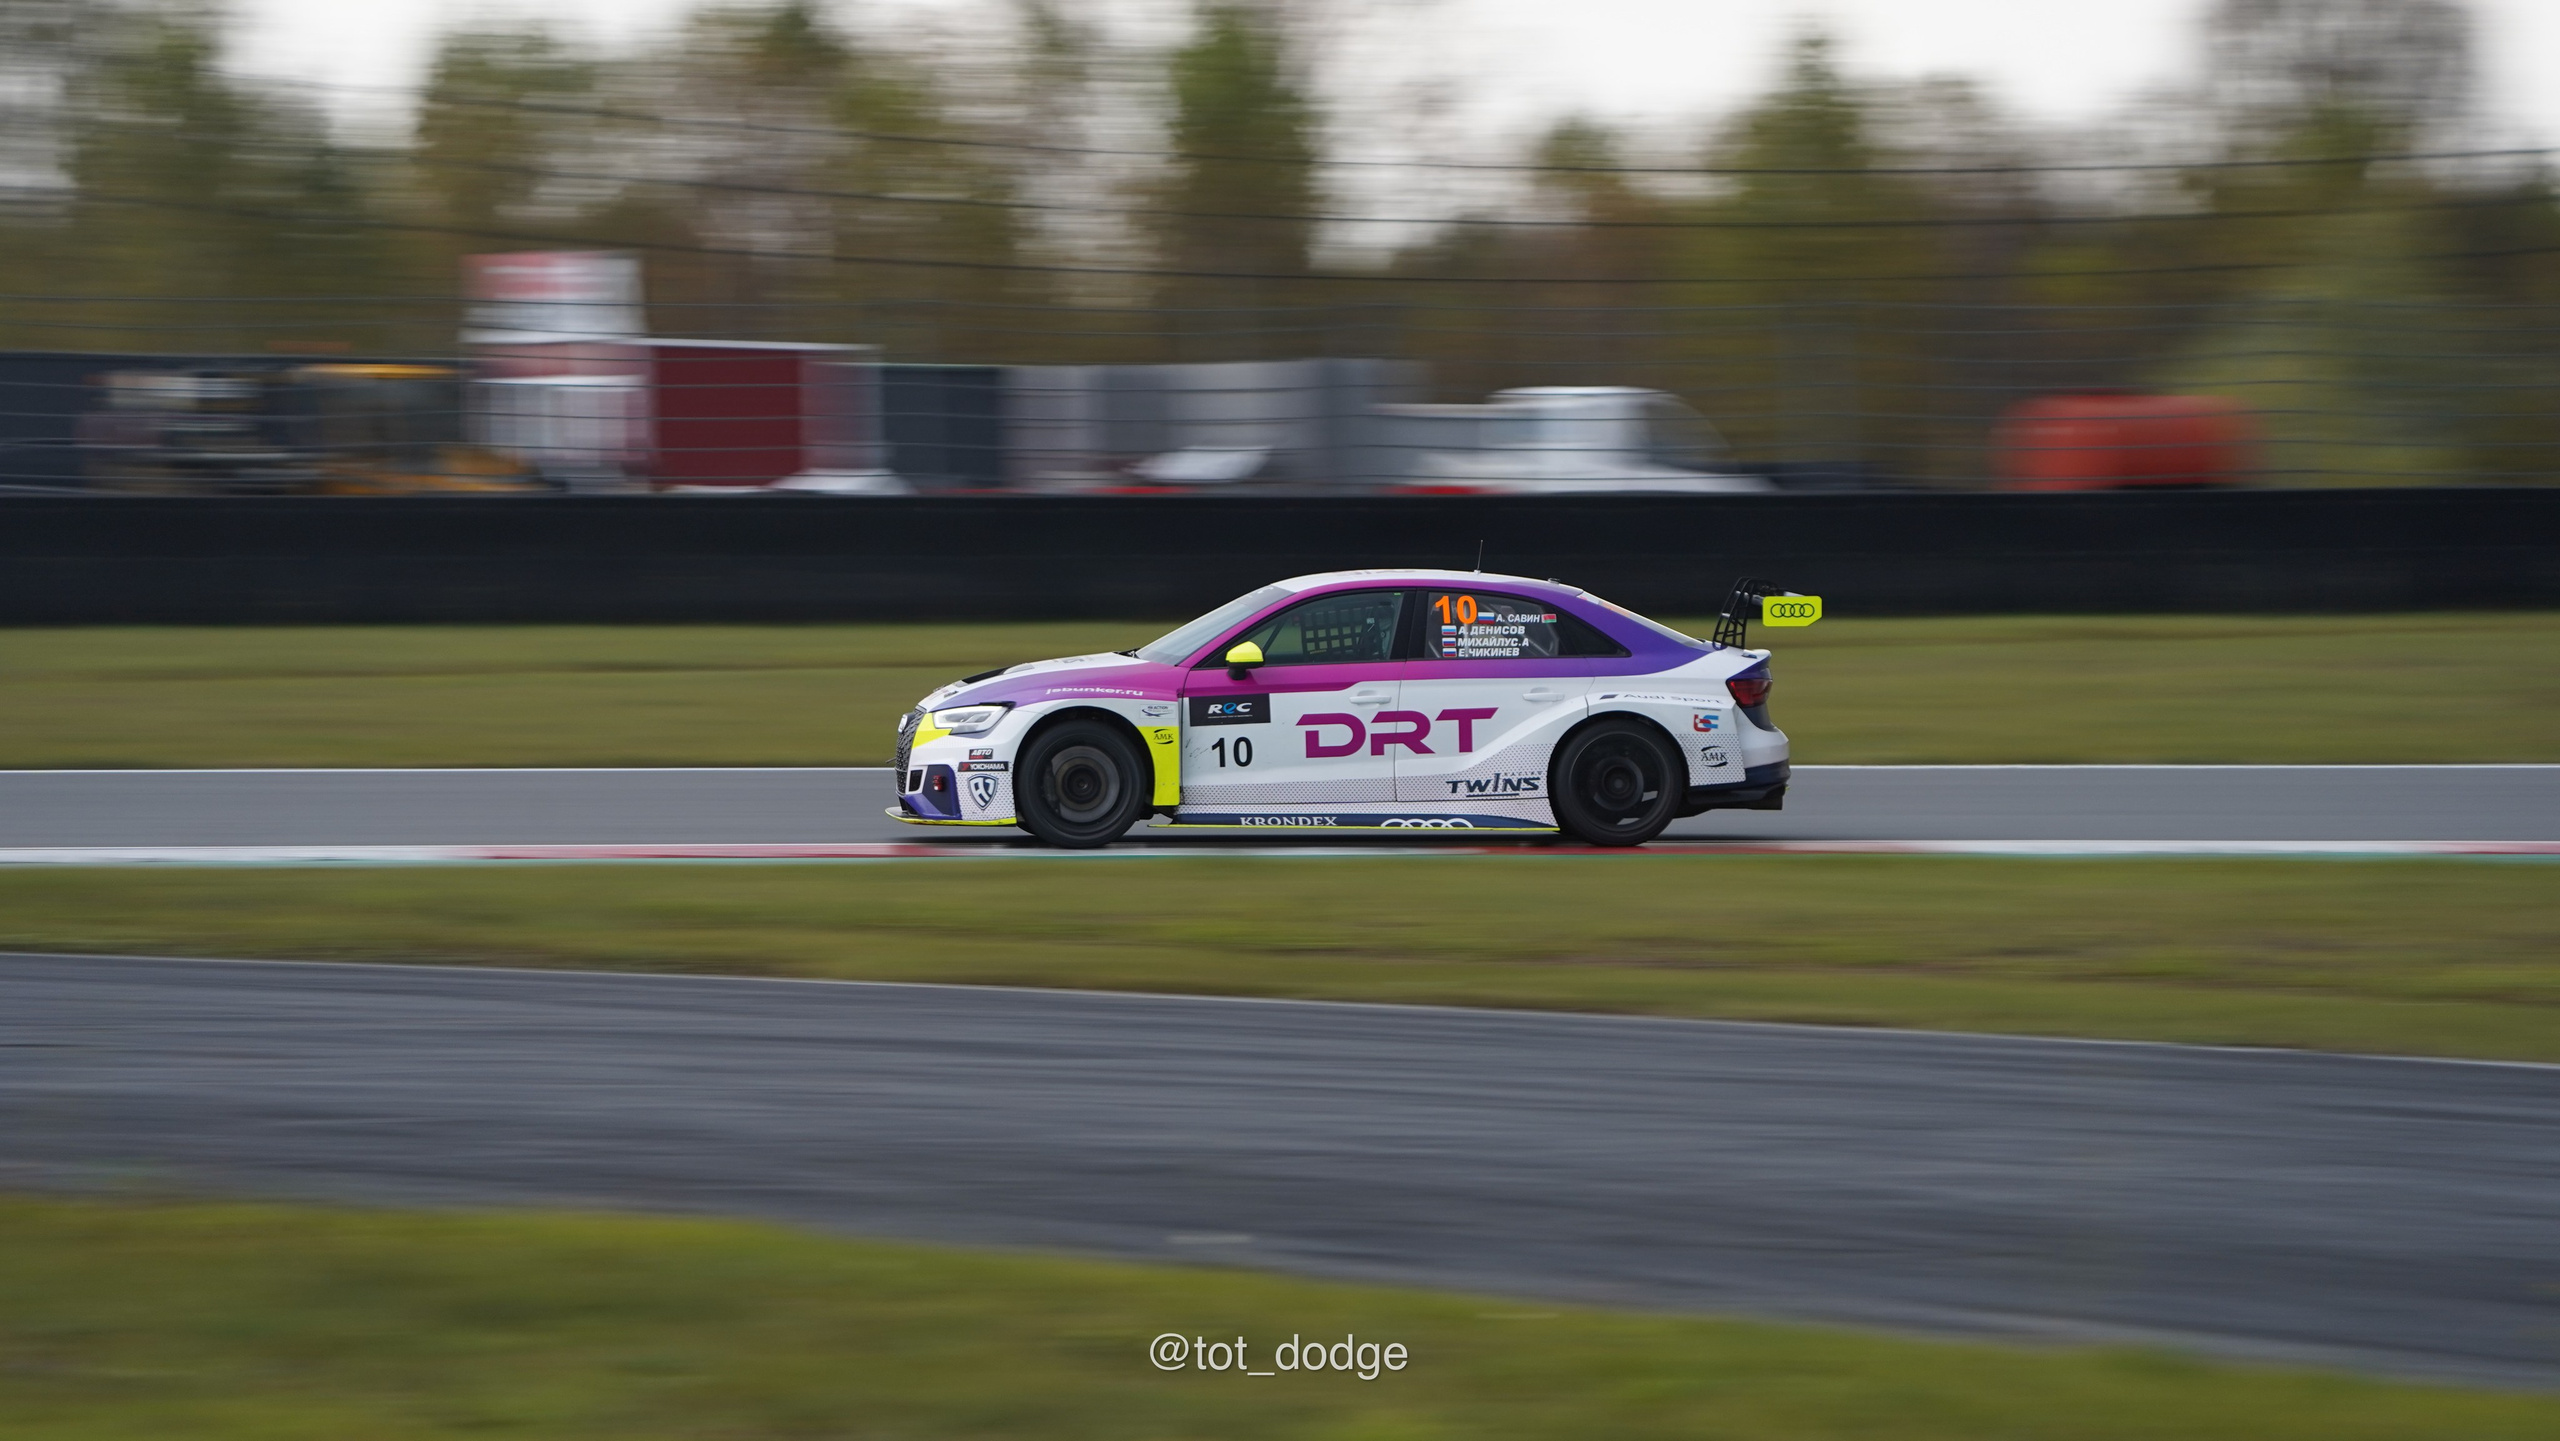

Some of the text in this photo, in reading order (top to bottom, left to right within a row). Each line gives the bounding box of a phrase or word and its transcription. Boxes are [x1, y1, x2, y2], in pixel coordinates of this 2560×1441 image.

[1434, 595, 1478, 625] 10
[1508, 613, 1541, 624] САВИН
[1295, 707, 1499, 758] DRT
[1211, 736, 1253, 768] 10
[1446, 773, 1541, 794] TWINS
[1240, 816, 1338, 826] KRONDEX
